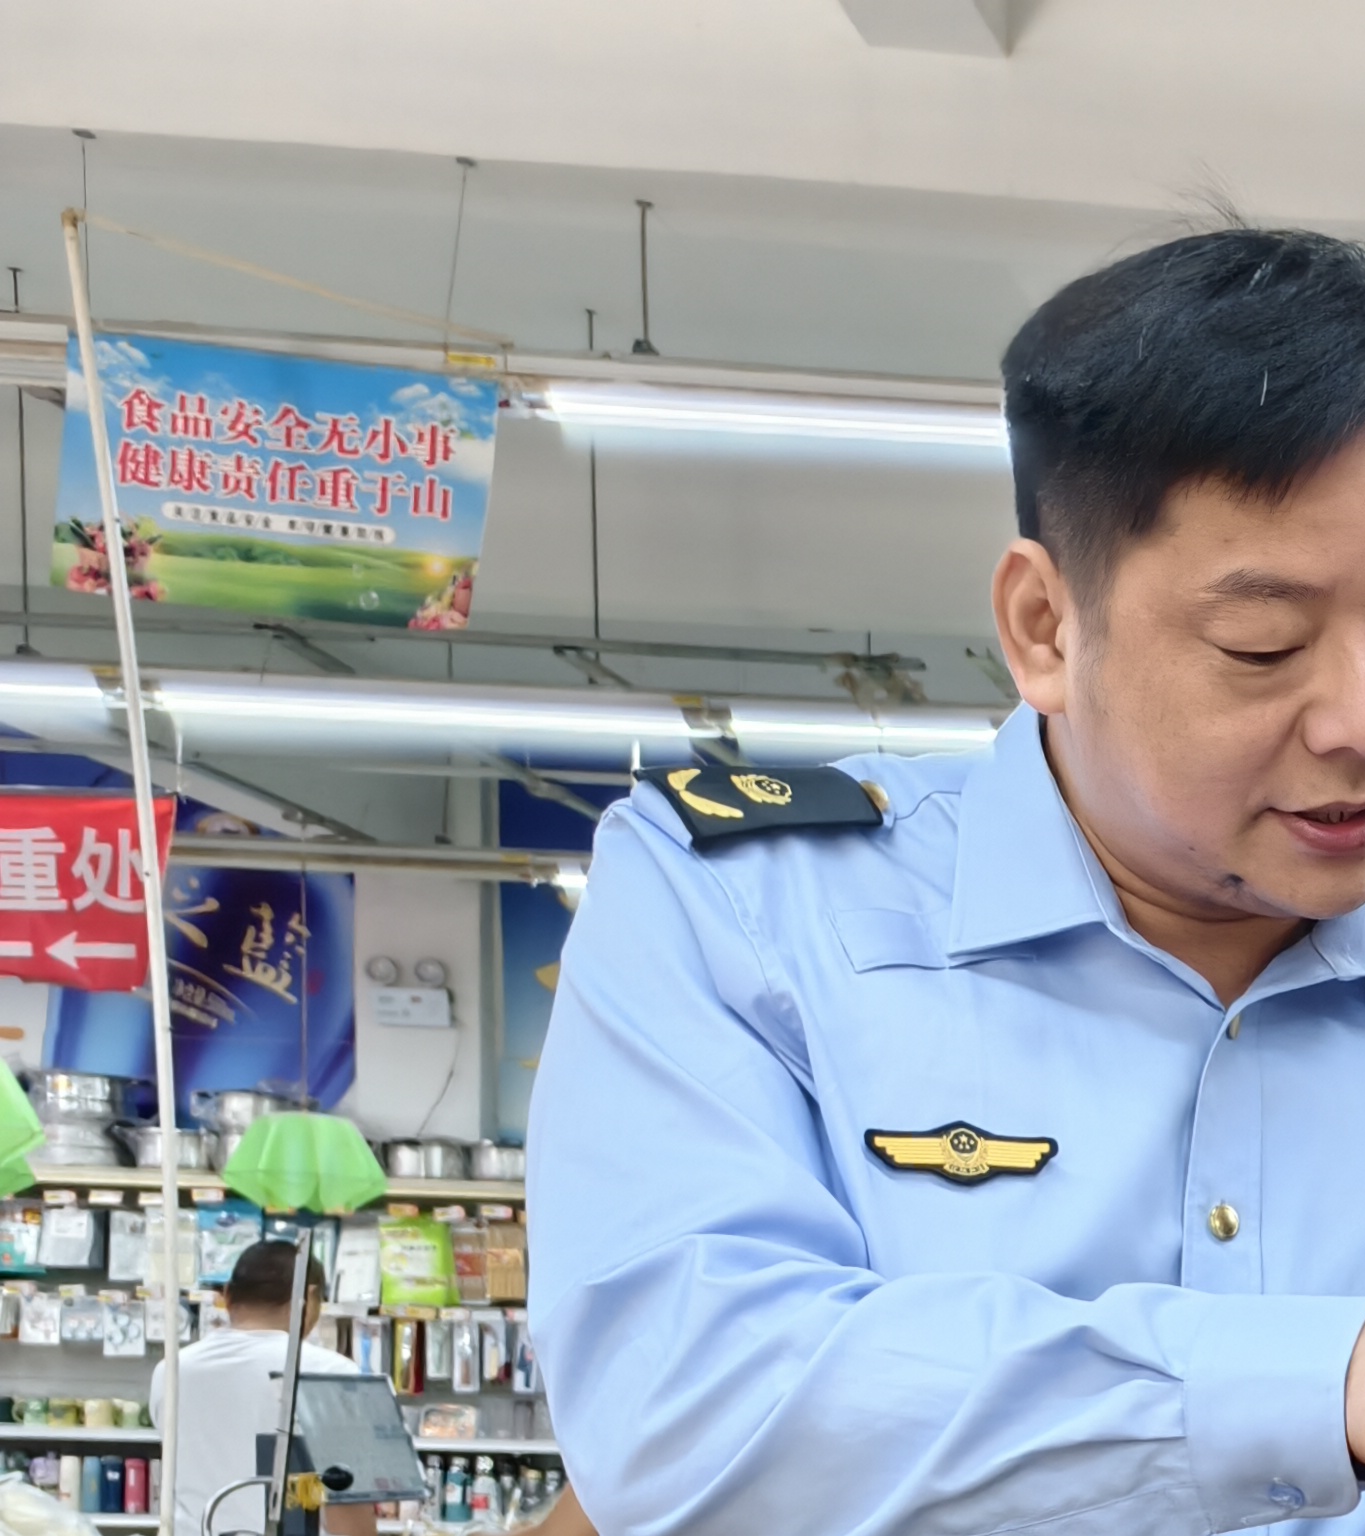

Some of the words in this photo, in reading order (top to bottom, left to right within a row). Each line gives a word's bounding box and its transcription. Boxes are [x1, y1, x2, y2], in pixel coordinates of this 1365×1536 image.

[117, 387, 456, 467] 食品安全无小事
[116, 440, 453, 522] 健康责任重于山
[0, 828, 146, 912] 重处
